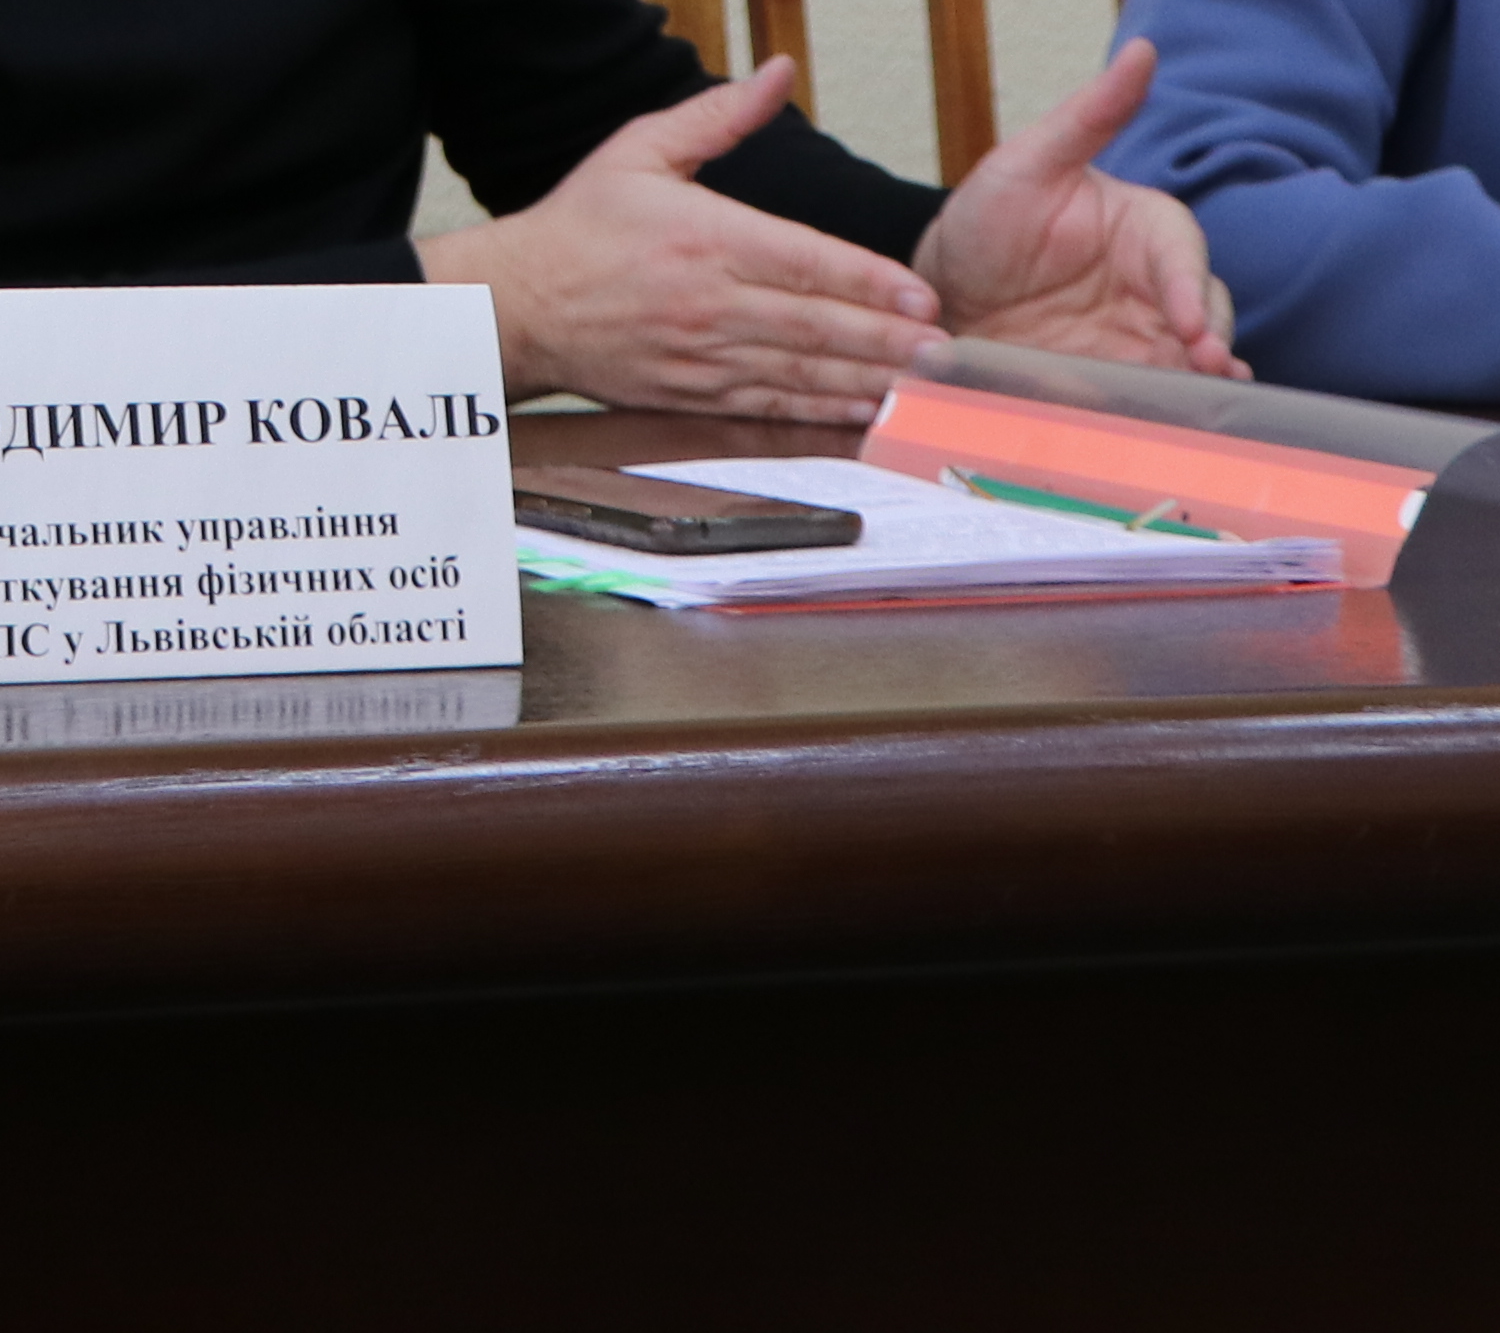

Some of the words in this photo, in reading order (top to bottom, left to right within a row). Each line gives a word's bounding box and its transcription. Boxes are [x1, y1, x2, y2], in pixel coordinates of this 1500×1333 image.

[247, 393, 501, 446] КОВАЛЬ
[176, 505, 400, 553] управління
[196, 562, 376, 606] фізичних
[388, 555, 462, 591] осіб
[62, 631, 84, 666] у
[95, 613, 315, 656] Львівській
[326, 608, 468, 647] області
